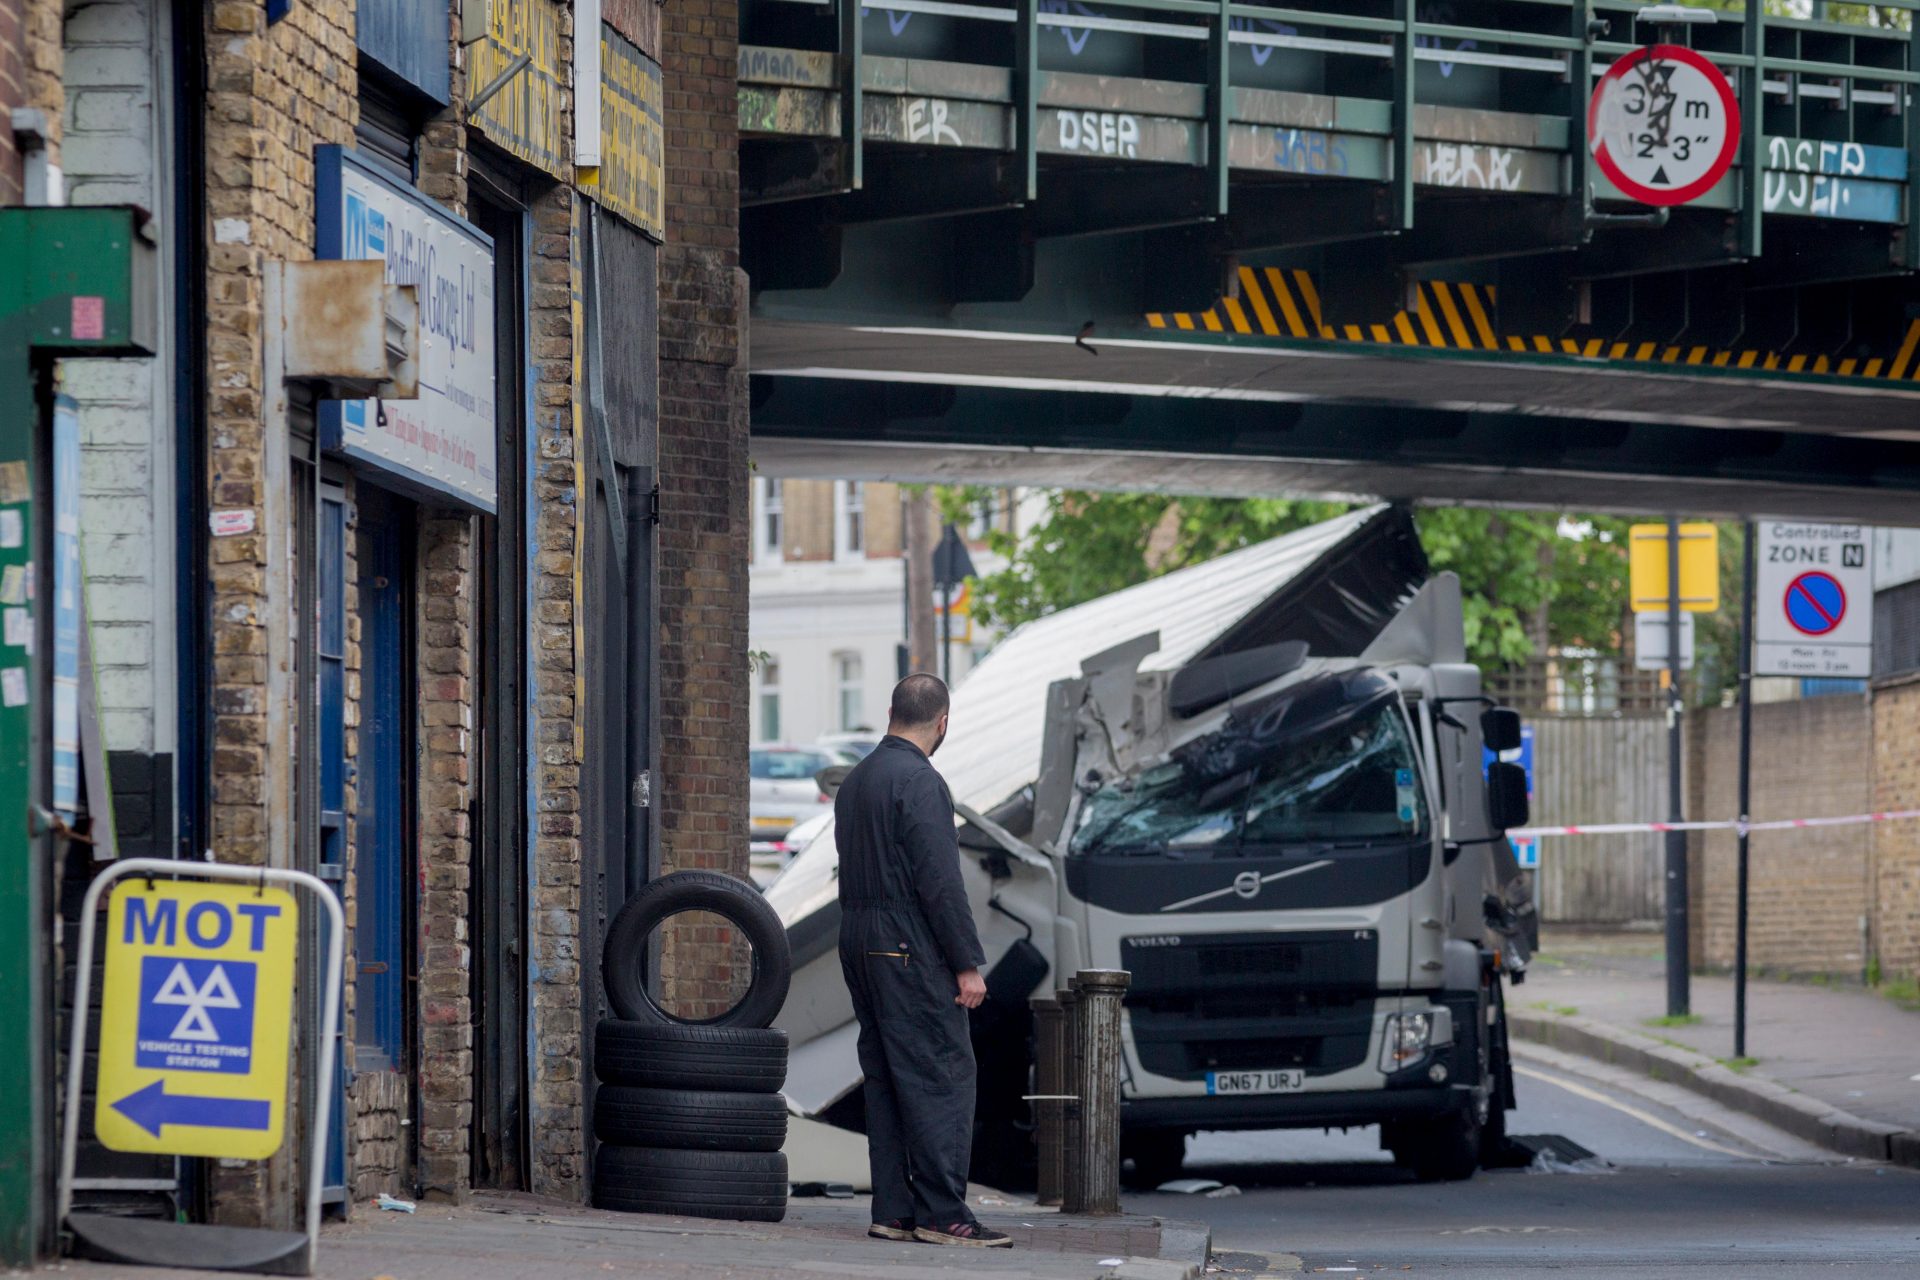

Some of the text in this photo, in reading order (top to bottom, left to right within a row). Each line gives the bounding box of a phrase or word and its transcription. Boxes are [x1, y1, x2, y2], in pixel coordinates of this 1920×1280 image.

[427, 244, 459, 369] Garage
[460, 263, 476, 354] Ltd
[1772, 523, 1861, 540] Controlled
[1769, 544, 1862, 566] ZONE N
[123, 897, 282, 952] MOT
[1127, 936, 1181, 947] VOLVO
[1354, 930, 1372, 940] FL
[139, 1040, 249, 1058] VEHICLE TESTING
[165, 1055, 221, 1069] STATION
[1217, 1073, 1302, 1091] GN67 URJ
